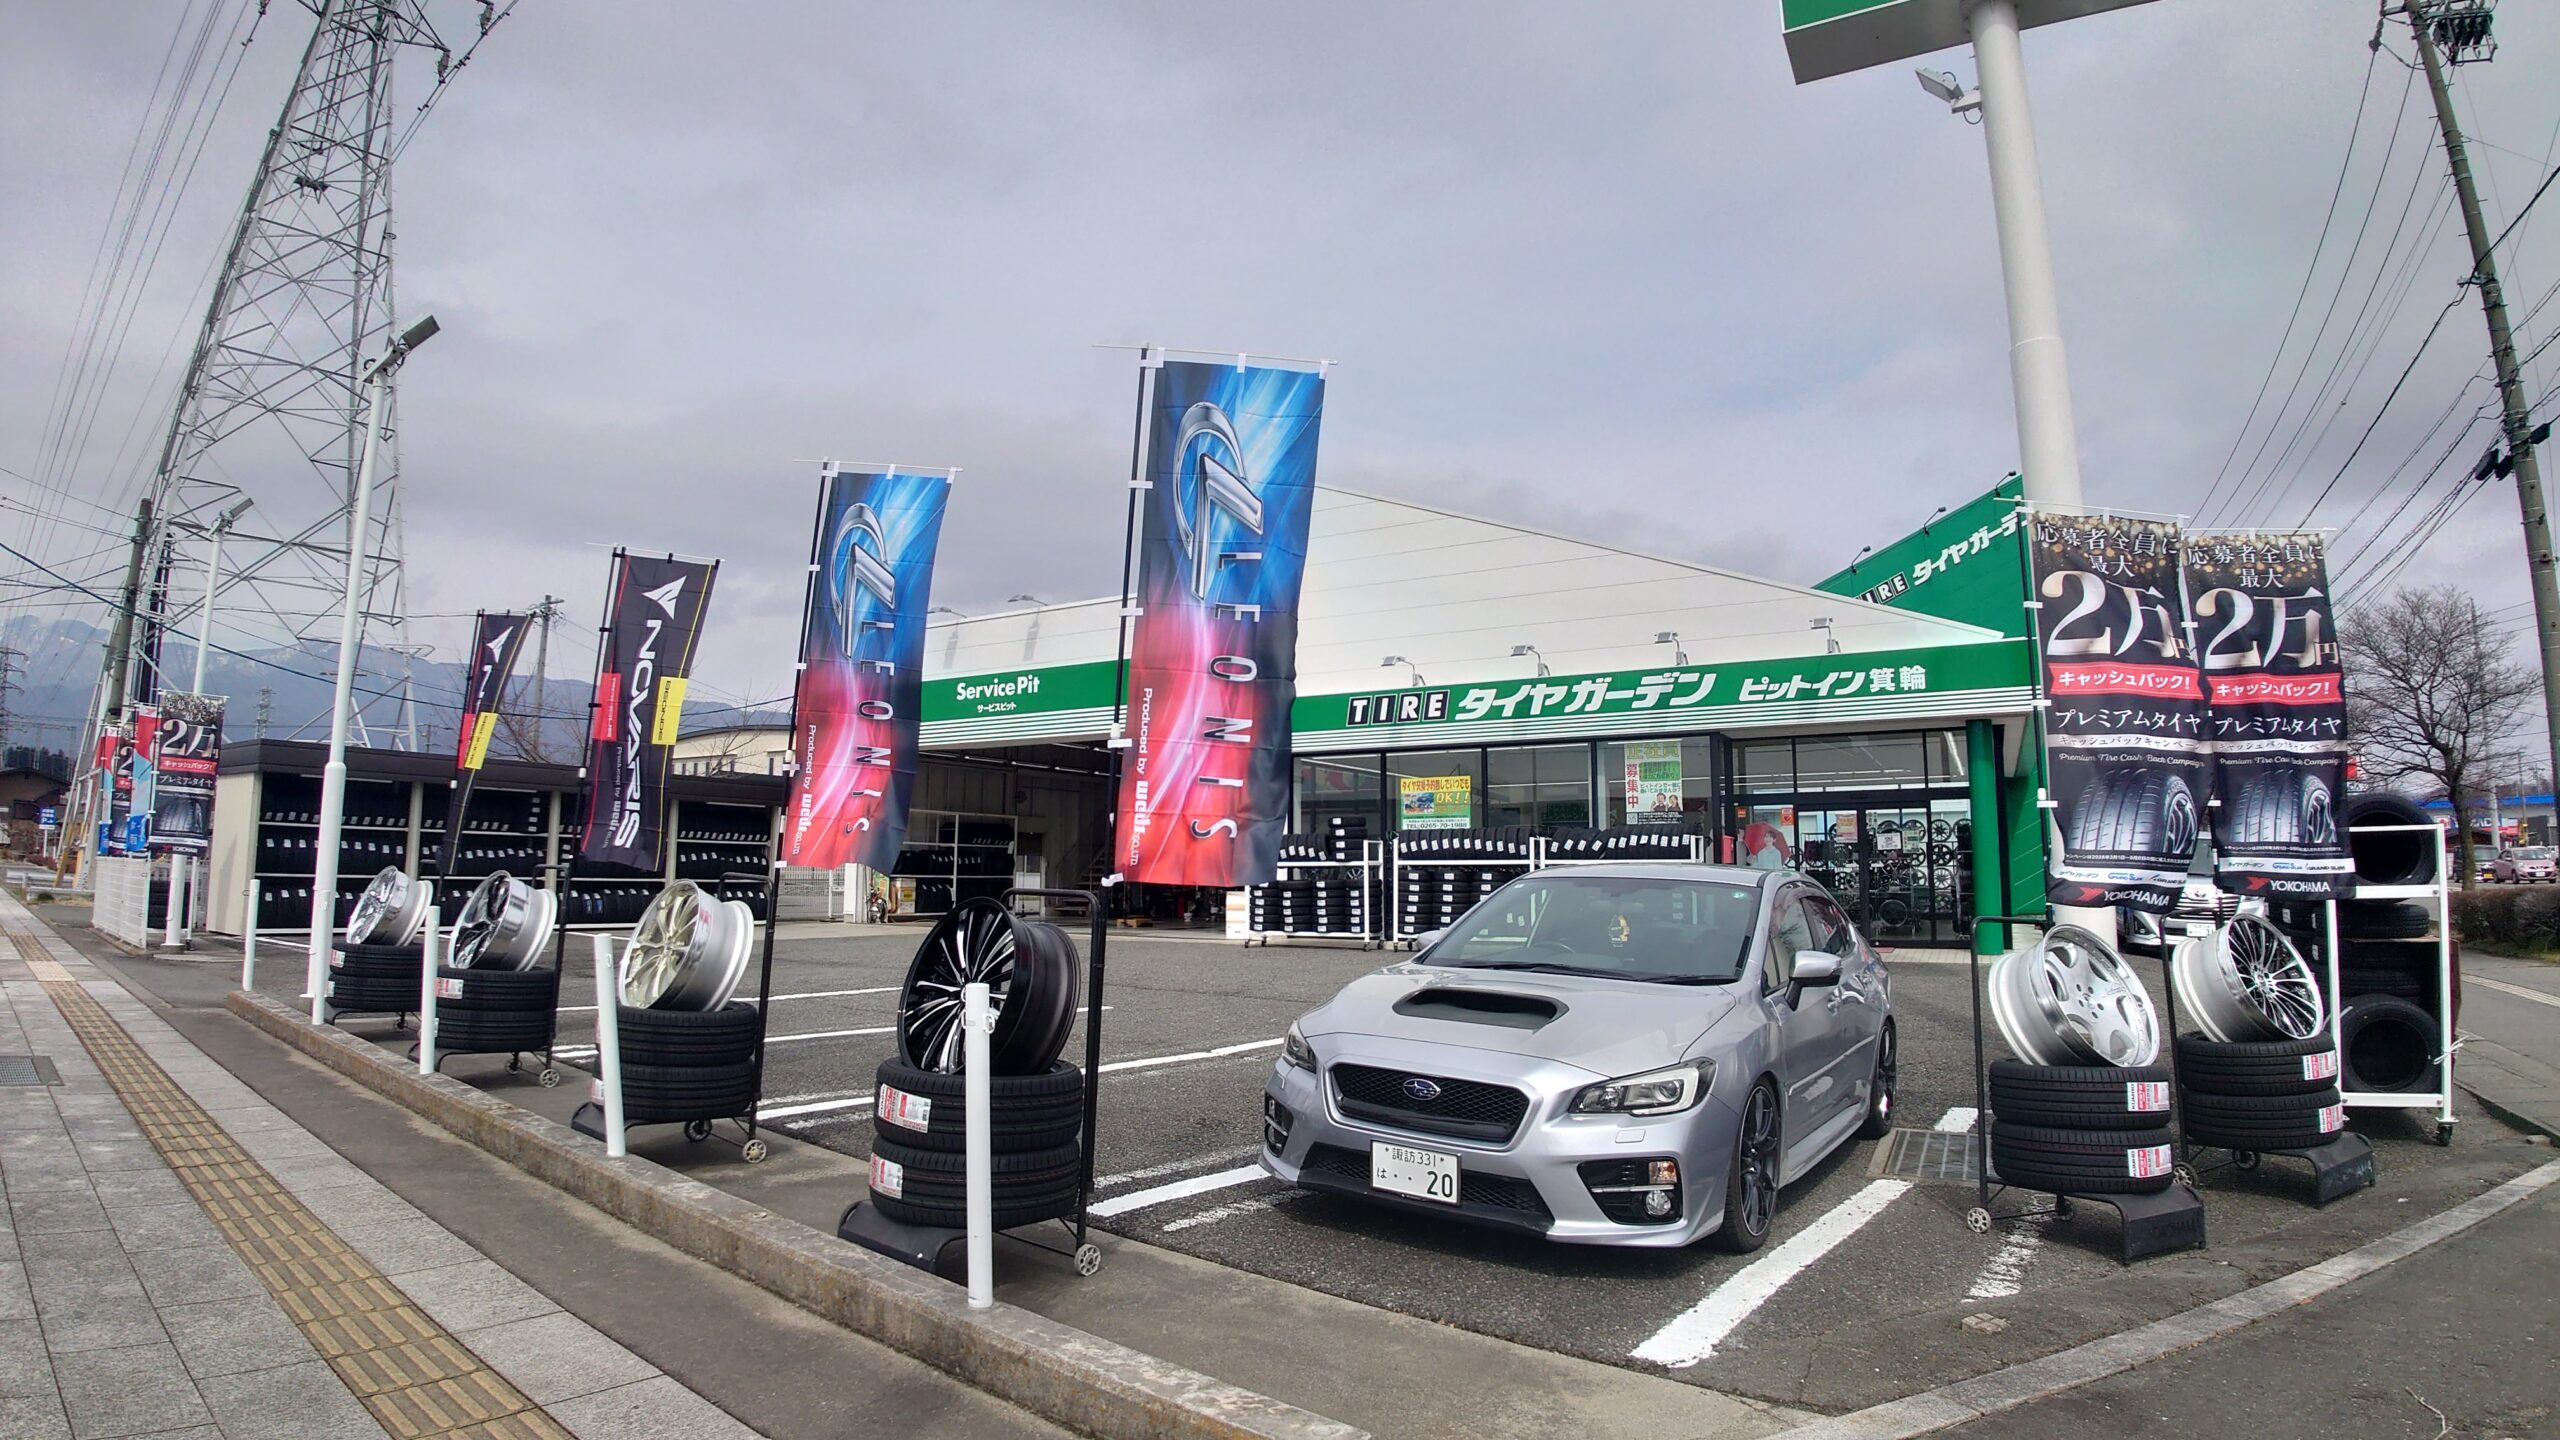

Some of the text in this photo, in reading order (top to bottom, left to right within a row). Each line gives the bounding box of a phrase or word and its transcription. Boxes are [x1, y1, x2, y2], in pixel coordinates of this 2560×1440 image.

[1912, 510, 2027, 586] タイヤガーデ
[2036, 521, 2178, 557] 応募者全員に
[2089, 554, 2136, 578] 最大
[2187, 544, 2324, 565] 応募者全員に
[1857, 572, 1909, 604] IRE
[2239, 568, 2285, 588] 最大
[2195, 586, 2340, 669] 2万円
[956, 674, 1040, 701] Service Pit
[1455, 664, 1926, 721] タイヤガーデン ピットイン 箕輪
[2058, 670, 2191, 690] キャッシュバック!
[2216, 681, 2330, 697] キャッシュバック!
[976, 701, 1017, 713] サービスピット
[1190, 551, 1262, 840] LEONIS
[1349, 691, 1446, 725] TIRE
[845, 620, 895, 836] LEONIS
[1138, 688, 1153, 754] Produced
[2054, 708, 2201, 734] プレミアムタイヤ
[2214, 716, 2342, 736] プレミアムタイヤ
[614, 619, 663, 850] NOVARIS
[808, 724, 817, 774] Produced
[2058, 753, 2096, 762] Premium
[2098, 753, 2120, 762] Tire
[2219, 757, 2252, 765] Premium
[613, 747, 623, 784] Produced
[1136, 757, 1149, 775] by
[613, 786, 622, 798] by
[803, 776, 813, 790] by
[2103, 889, 2170, 907] YOKOHAMA
[2269, 879, 2332, 893] YOKOHAMA
[1376, 1167, 1453, 1198] は 20
